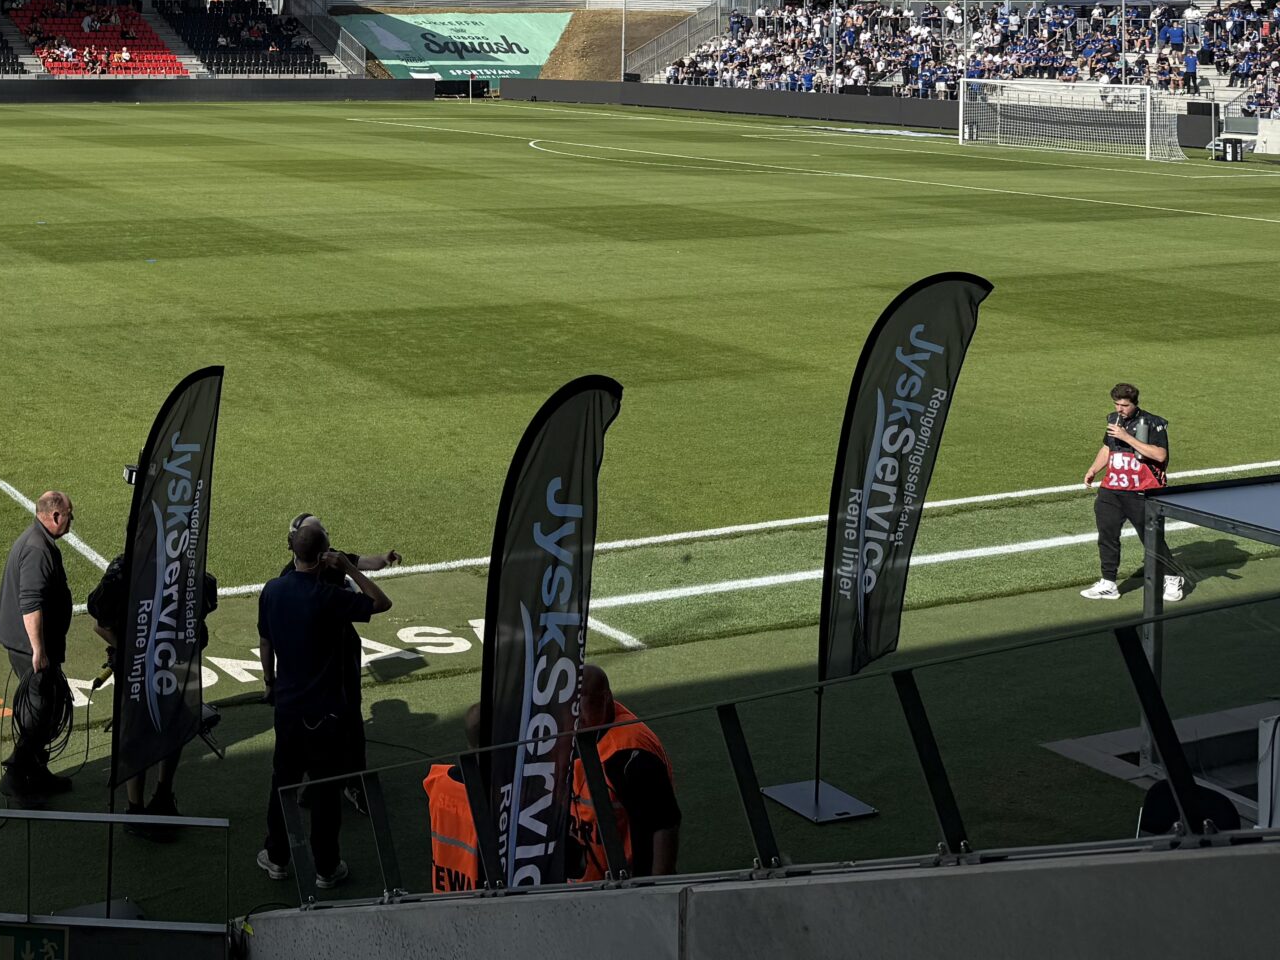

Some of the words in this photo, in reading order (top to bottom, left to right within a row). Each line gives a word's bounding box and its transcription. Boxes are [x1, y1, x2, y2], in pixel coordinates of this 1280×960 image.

[420, 32, 530, 59] Squash
[862, 323, 945, 594] JyskService
[893, 387, 948, 547] Rengøringsselskabet
[1108, 472, 1140, 488] 231
[843, 488, 863, 540] Rene
[152, 430, 201, 697] JyskService
[837, 546, 859, 600] linjer
[134, 598, 153, 649] Rene
[129, 653, 146, 702] linjer
[512, 476, 584, 888] JyskServic
